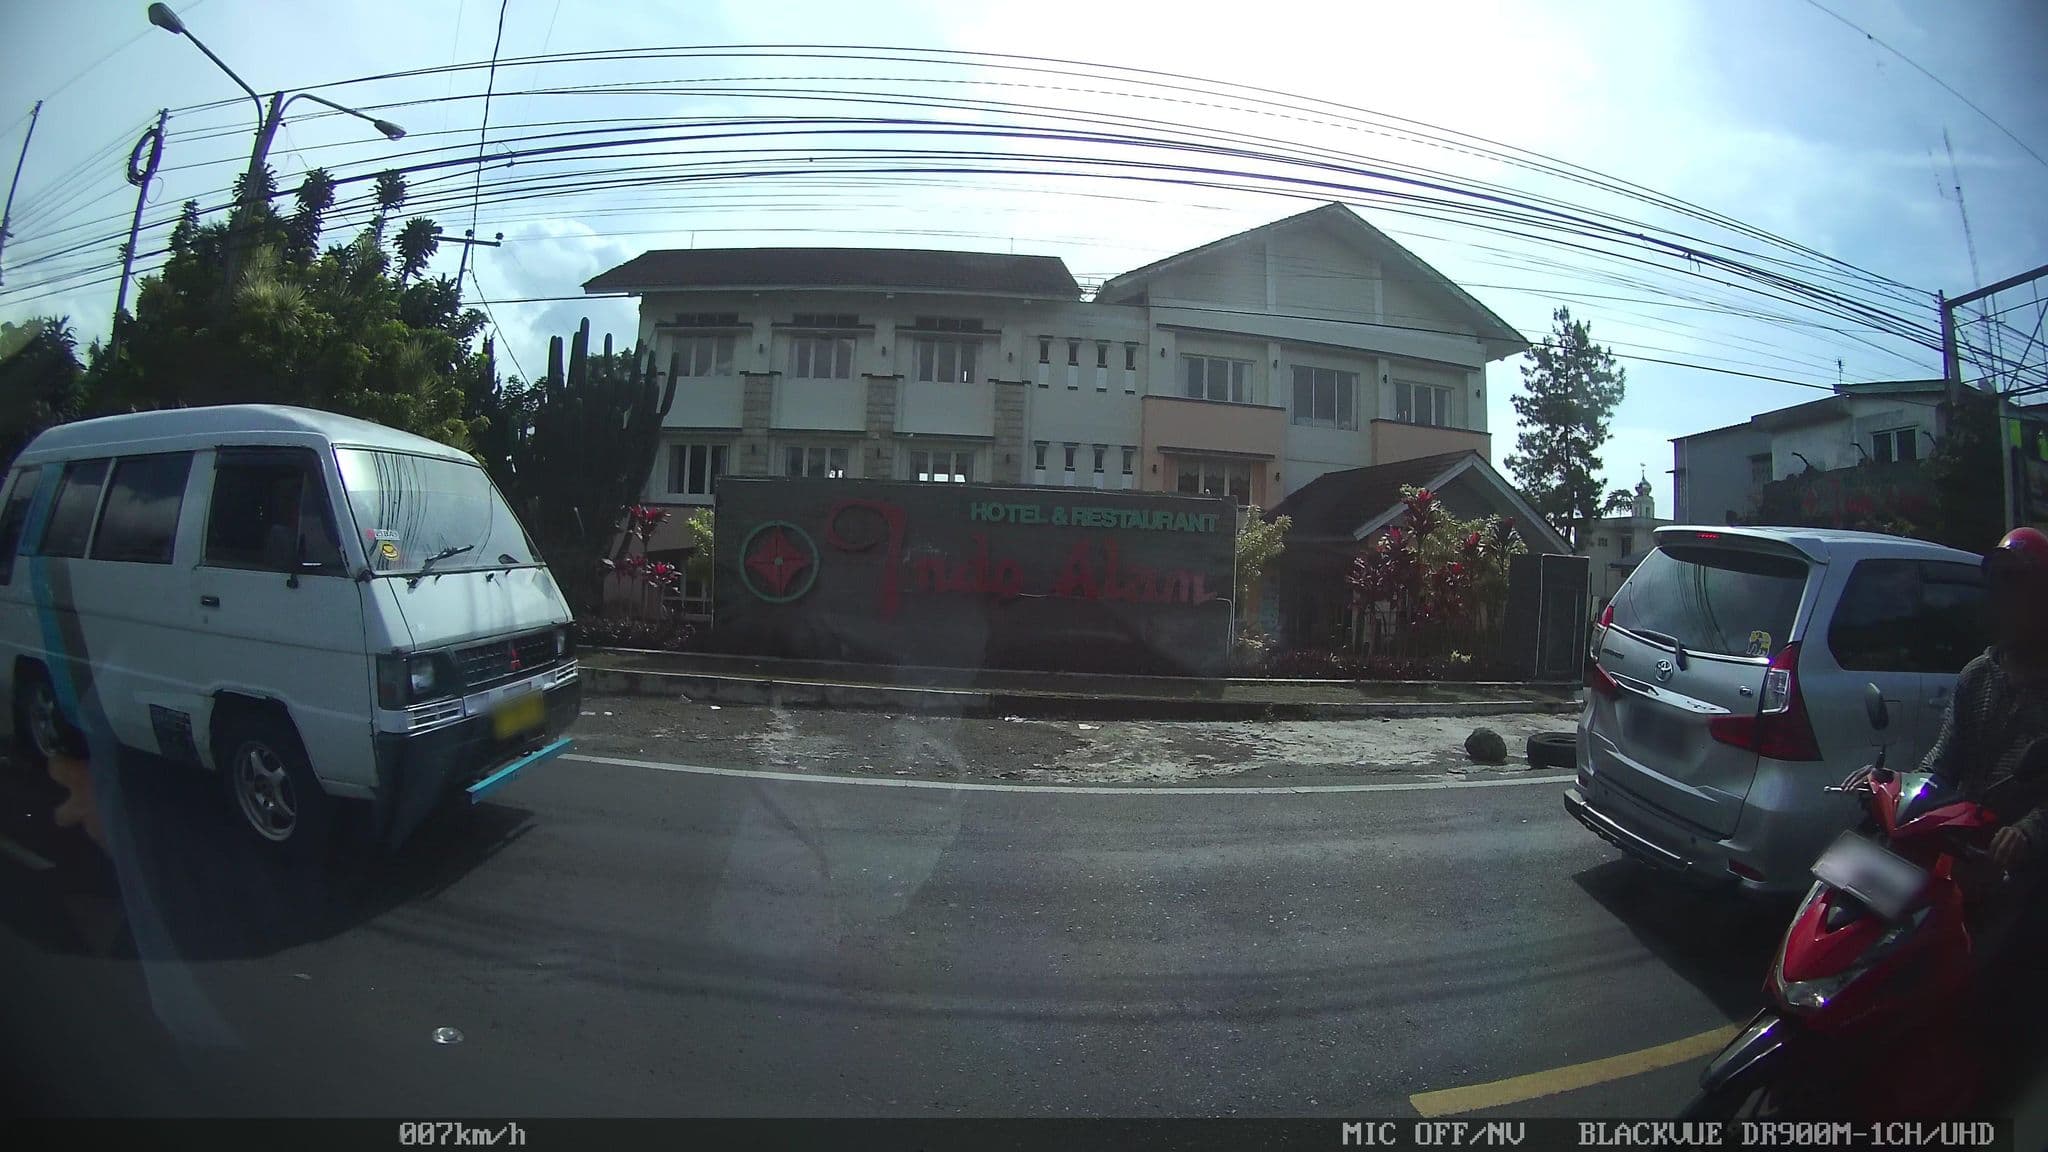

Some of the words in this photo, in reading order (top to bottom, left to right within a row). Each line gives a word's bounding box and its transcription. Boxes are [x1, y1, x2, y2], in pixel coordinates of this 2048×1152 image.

[972, 502, 1048, 525] HOTEL
[1052, 506, 1069, 527] &
[1072, 507, 1219, 532] RESTAURANT
[826, 498, 1023, 622] Indo
[1048, 536, 1215, 605] Alam
